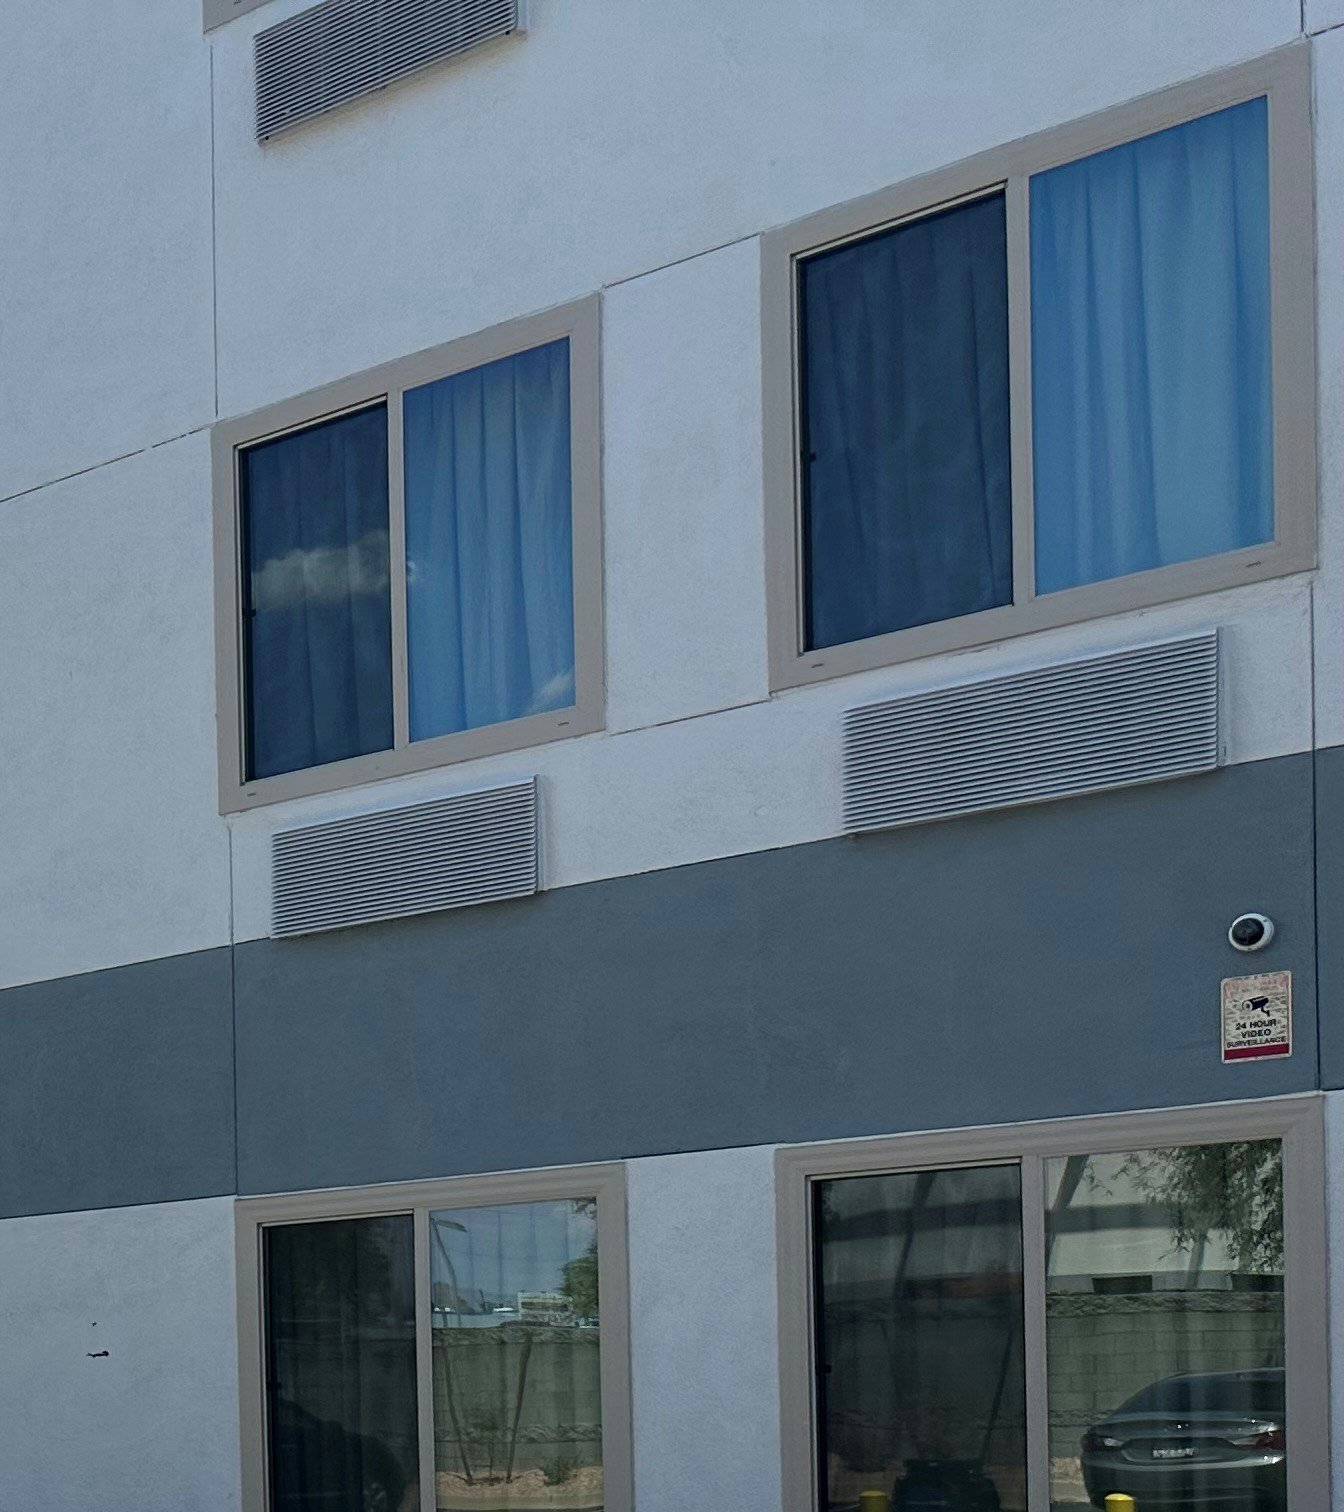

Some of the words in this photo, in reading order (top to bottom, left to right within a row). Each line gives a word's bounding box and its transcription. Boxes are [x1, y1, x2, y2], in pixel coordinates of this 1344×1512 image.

[1235, 1022, 1246, 1030] 24
[1249, 1018, 1277, 1028] HOUR
[1241, 1028, 1272, 1038] VIDEO
[1226, 1036, 1287, 1048] SURVEILLANCE
